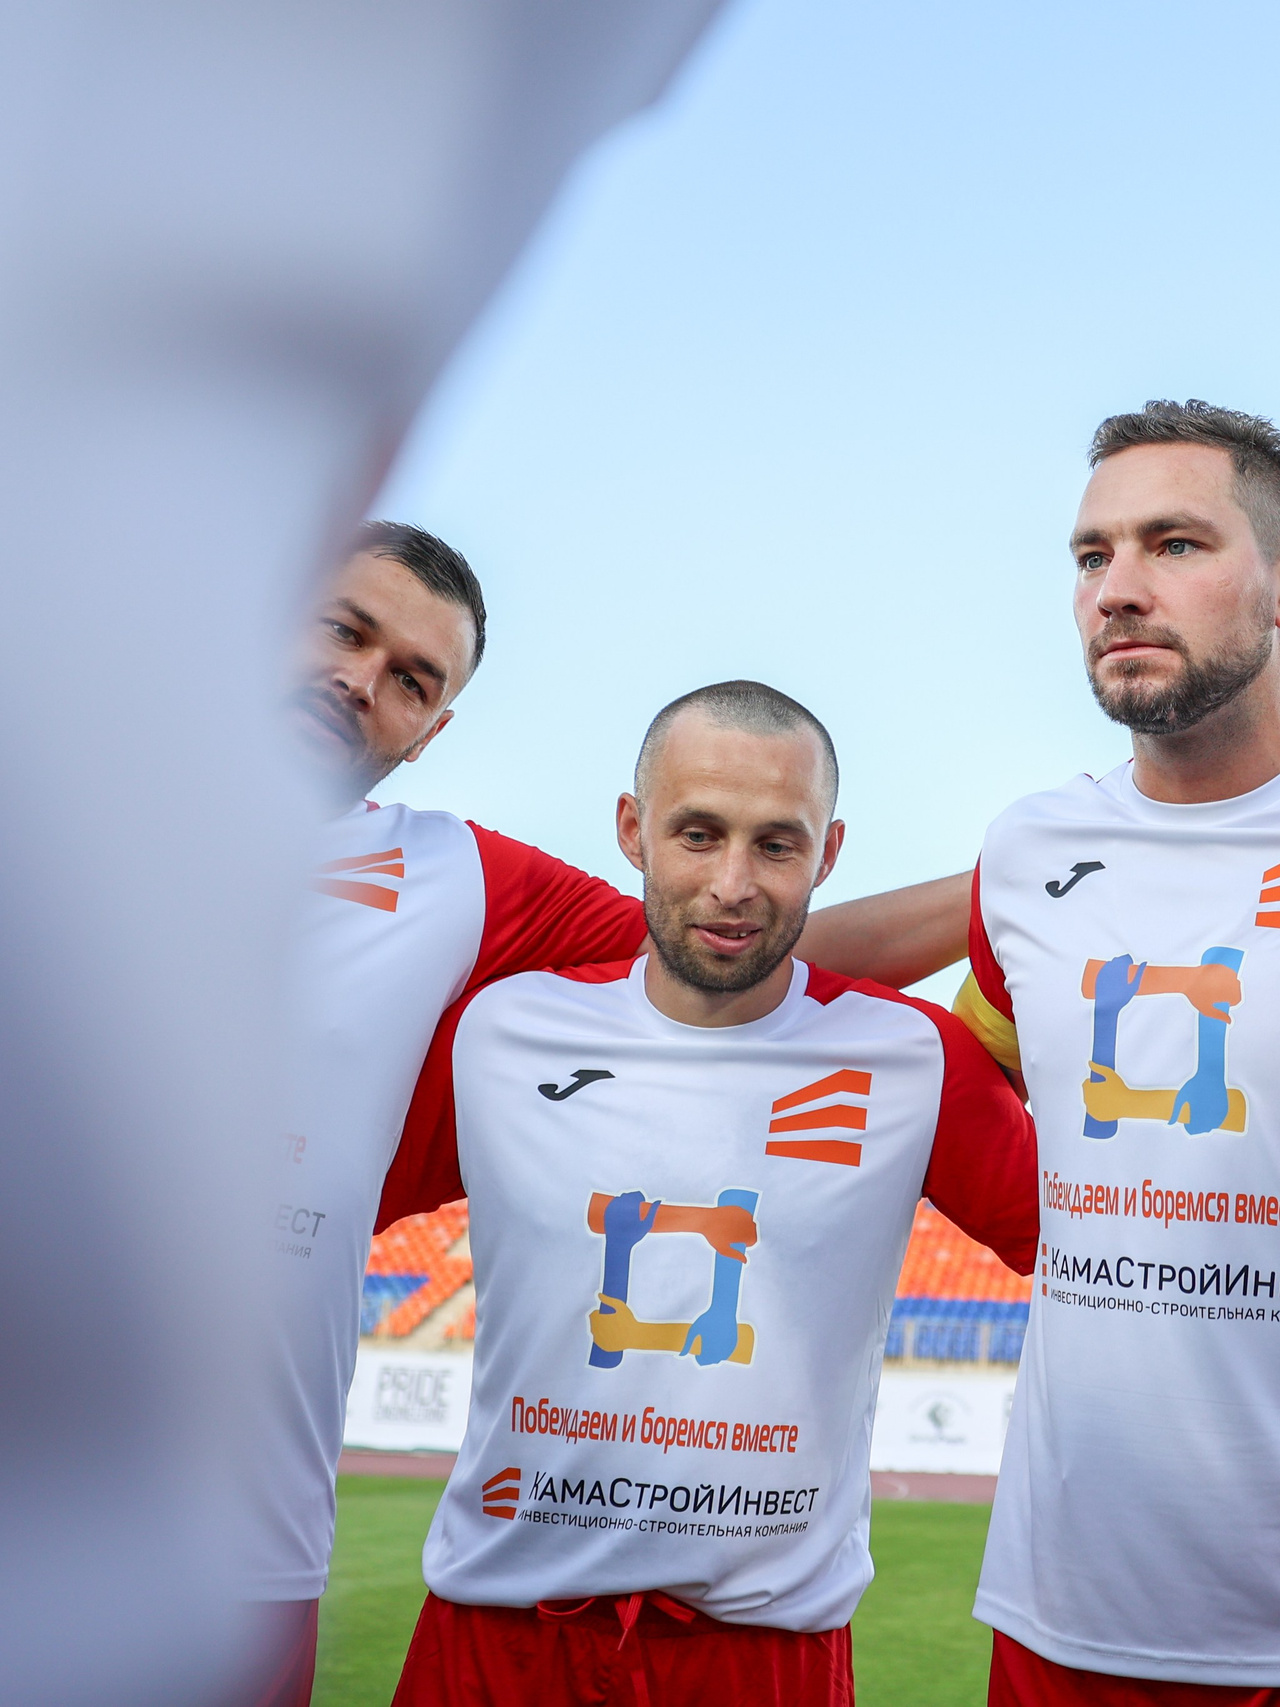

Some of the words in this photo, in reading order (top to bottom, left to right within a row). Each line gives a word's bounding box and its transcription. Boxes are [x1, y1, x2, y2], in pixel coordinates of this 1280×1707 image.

[1043, 1170, 1119, 1219] Побеждаем
[1124, 1187, 1137, 1217] и
[1141, 1179, 1229, 1229] боремся
[1050, 1288, 1266, 1322] ИНВЕСТИЦИОННО-СТРОИТЕЛЬНАЯ
[511, 1396, 618, 1444] Побеждаем
[622, 1413, 636, 1443] и
[640, 1406, 728, 1454] боремся
[731, 1423, 799, 1453] вместе
[518, 1508, 752, 1538] ИНВЕСТИЦИОННО-СТРОИТЕЛЬНАЯ
[754, 1521, 808, 1538] КОМПАНИЯ
